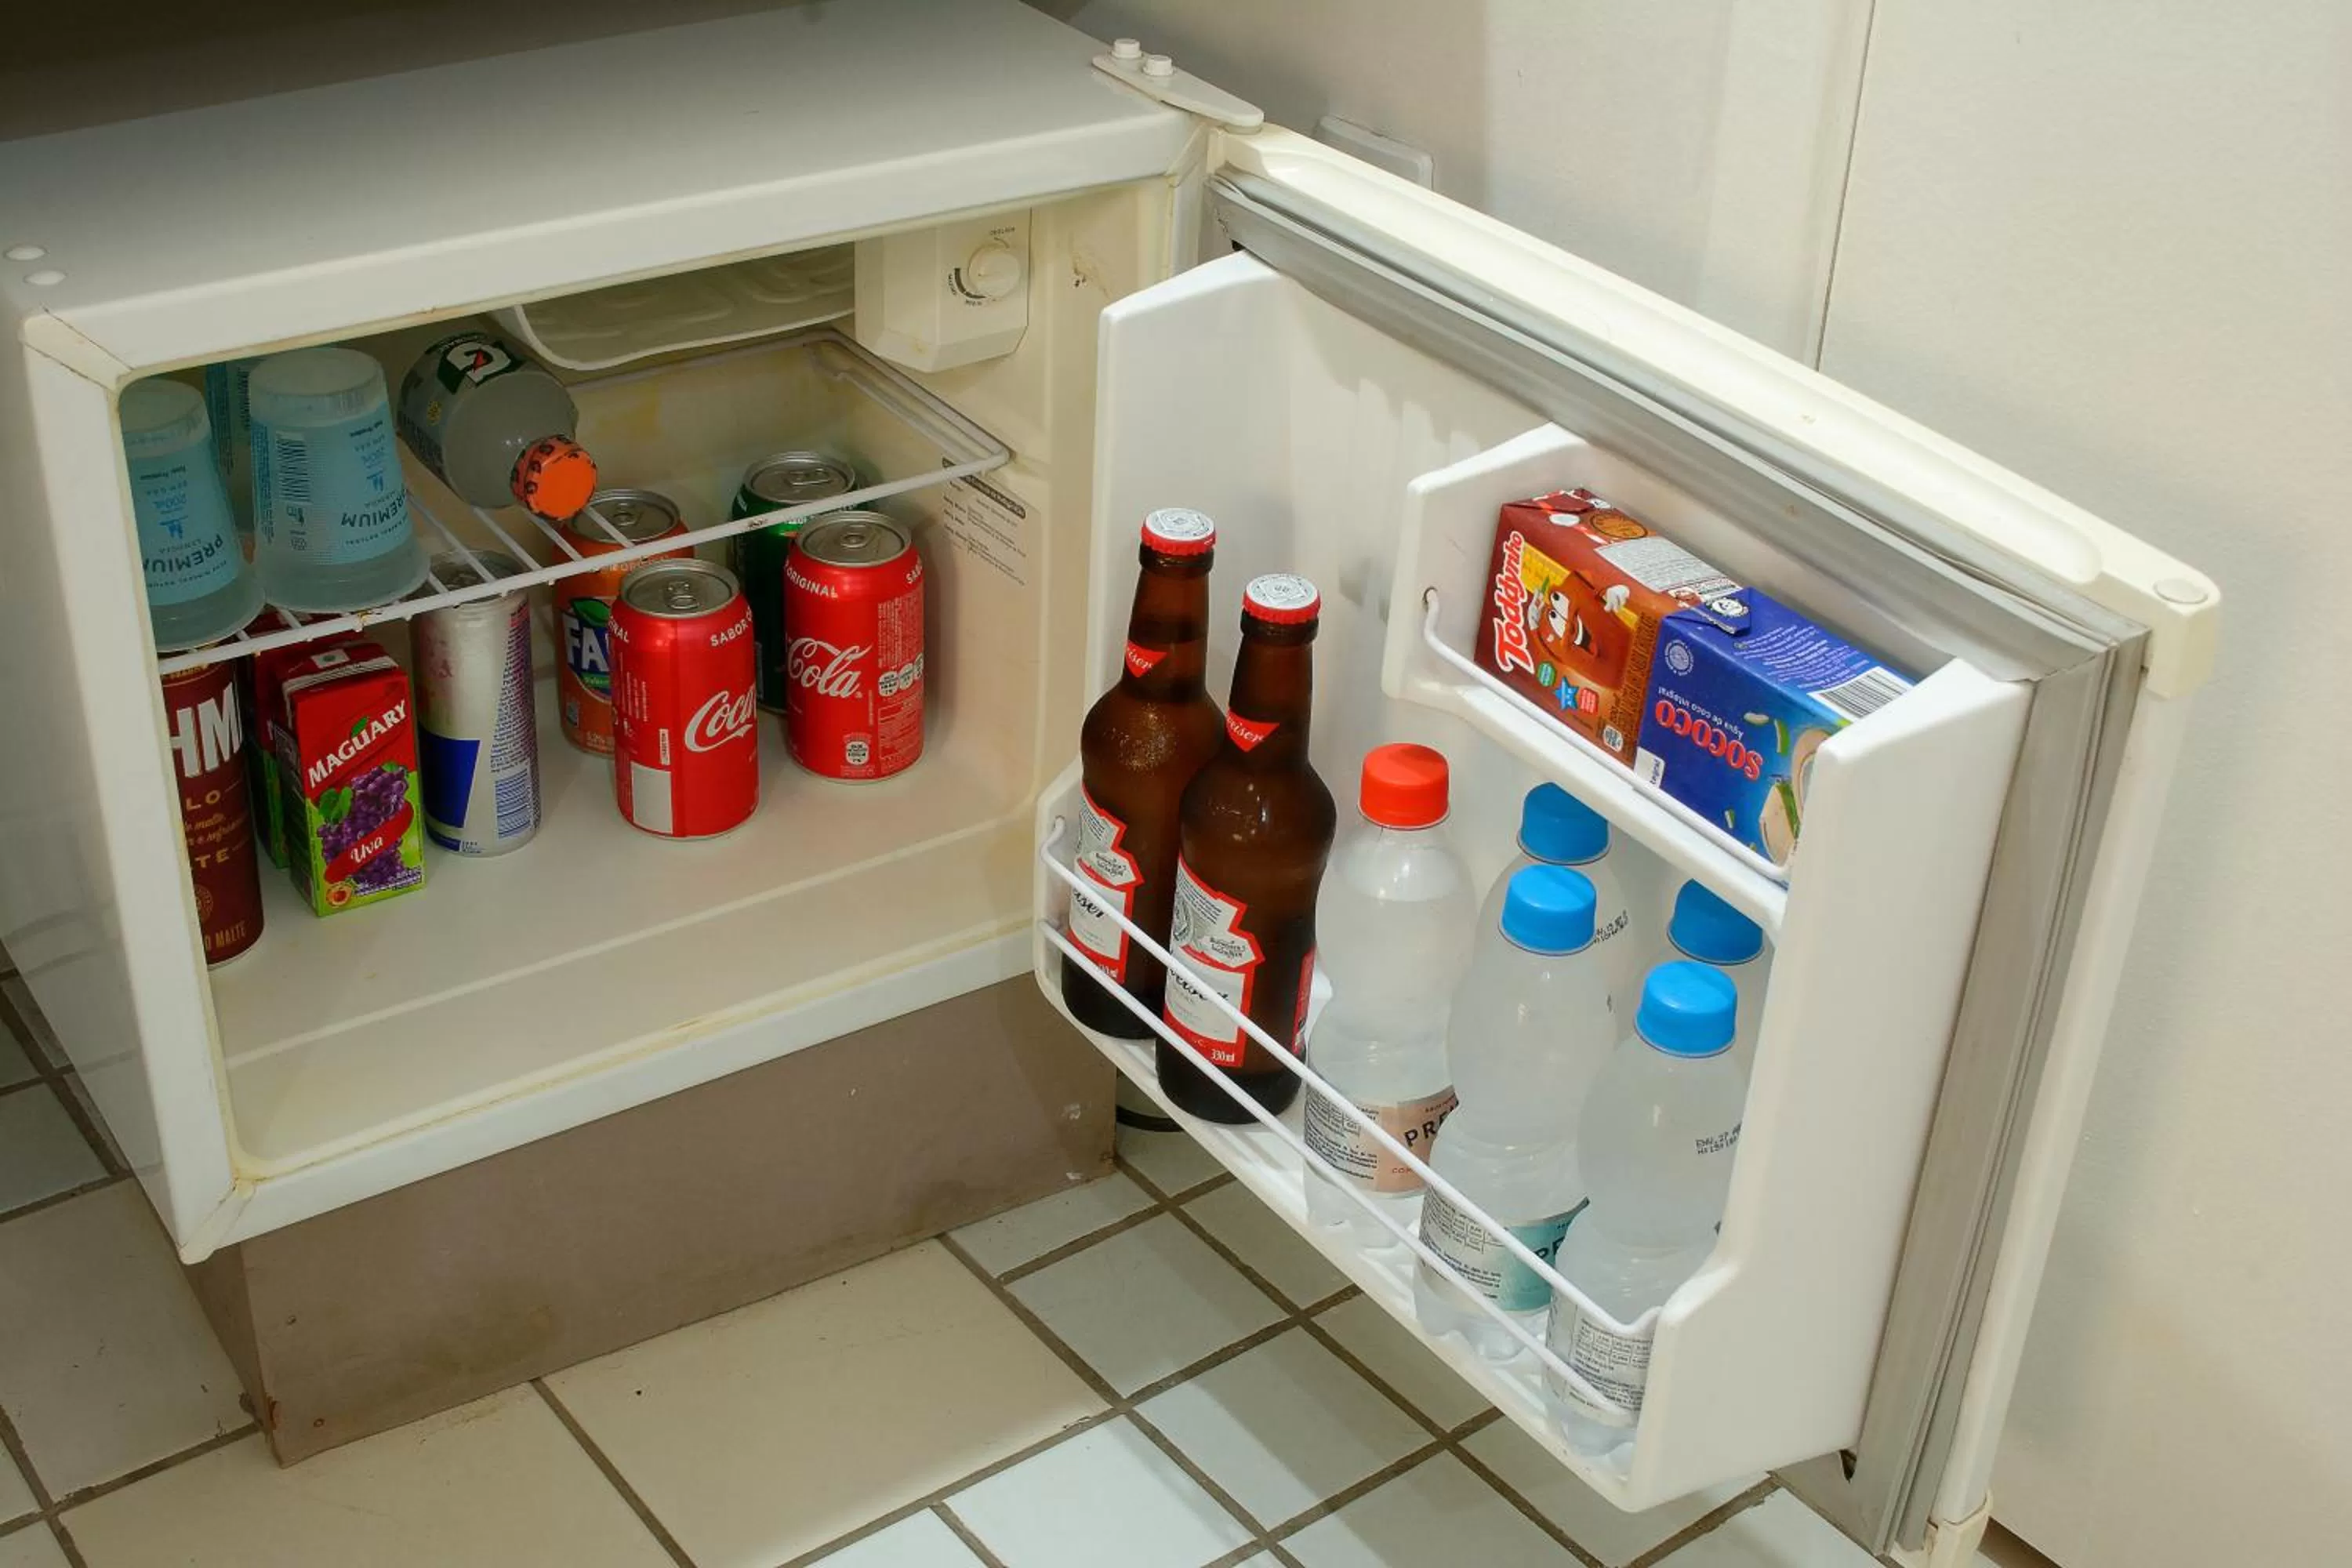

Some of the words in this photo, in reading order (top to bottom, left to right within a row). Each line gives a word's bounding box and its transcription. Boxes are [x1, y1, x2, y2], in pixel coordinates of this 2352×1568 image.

[786, 567, 838, 598] ORIGINAL
[1494, 531, 1534, 674] Toddynho
[562, 612, 611, 672] FA
[710, 619, 748, 647] SABOR
[1127, 645, 1153, 669] iser
[788, 637, 873, 698] Cola
[169, 681, 243, 778] HM
[308, 699, 406, 789] MAGUARY
[1227, 715, 1265, 742] eiser
[1655, 699, 1763, 780] SOCOCO
[351, 836, 383, 863] Uva
